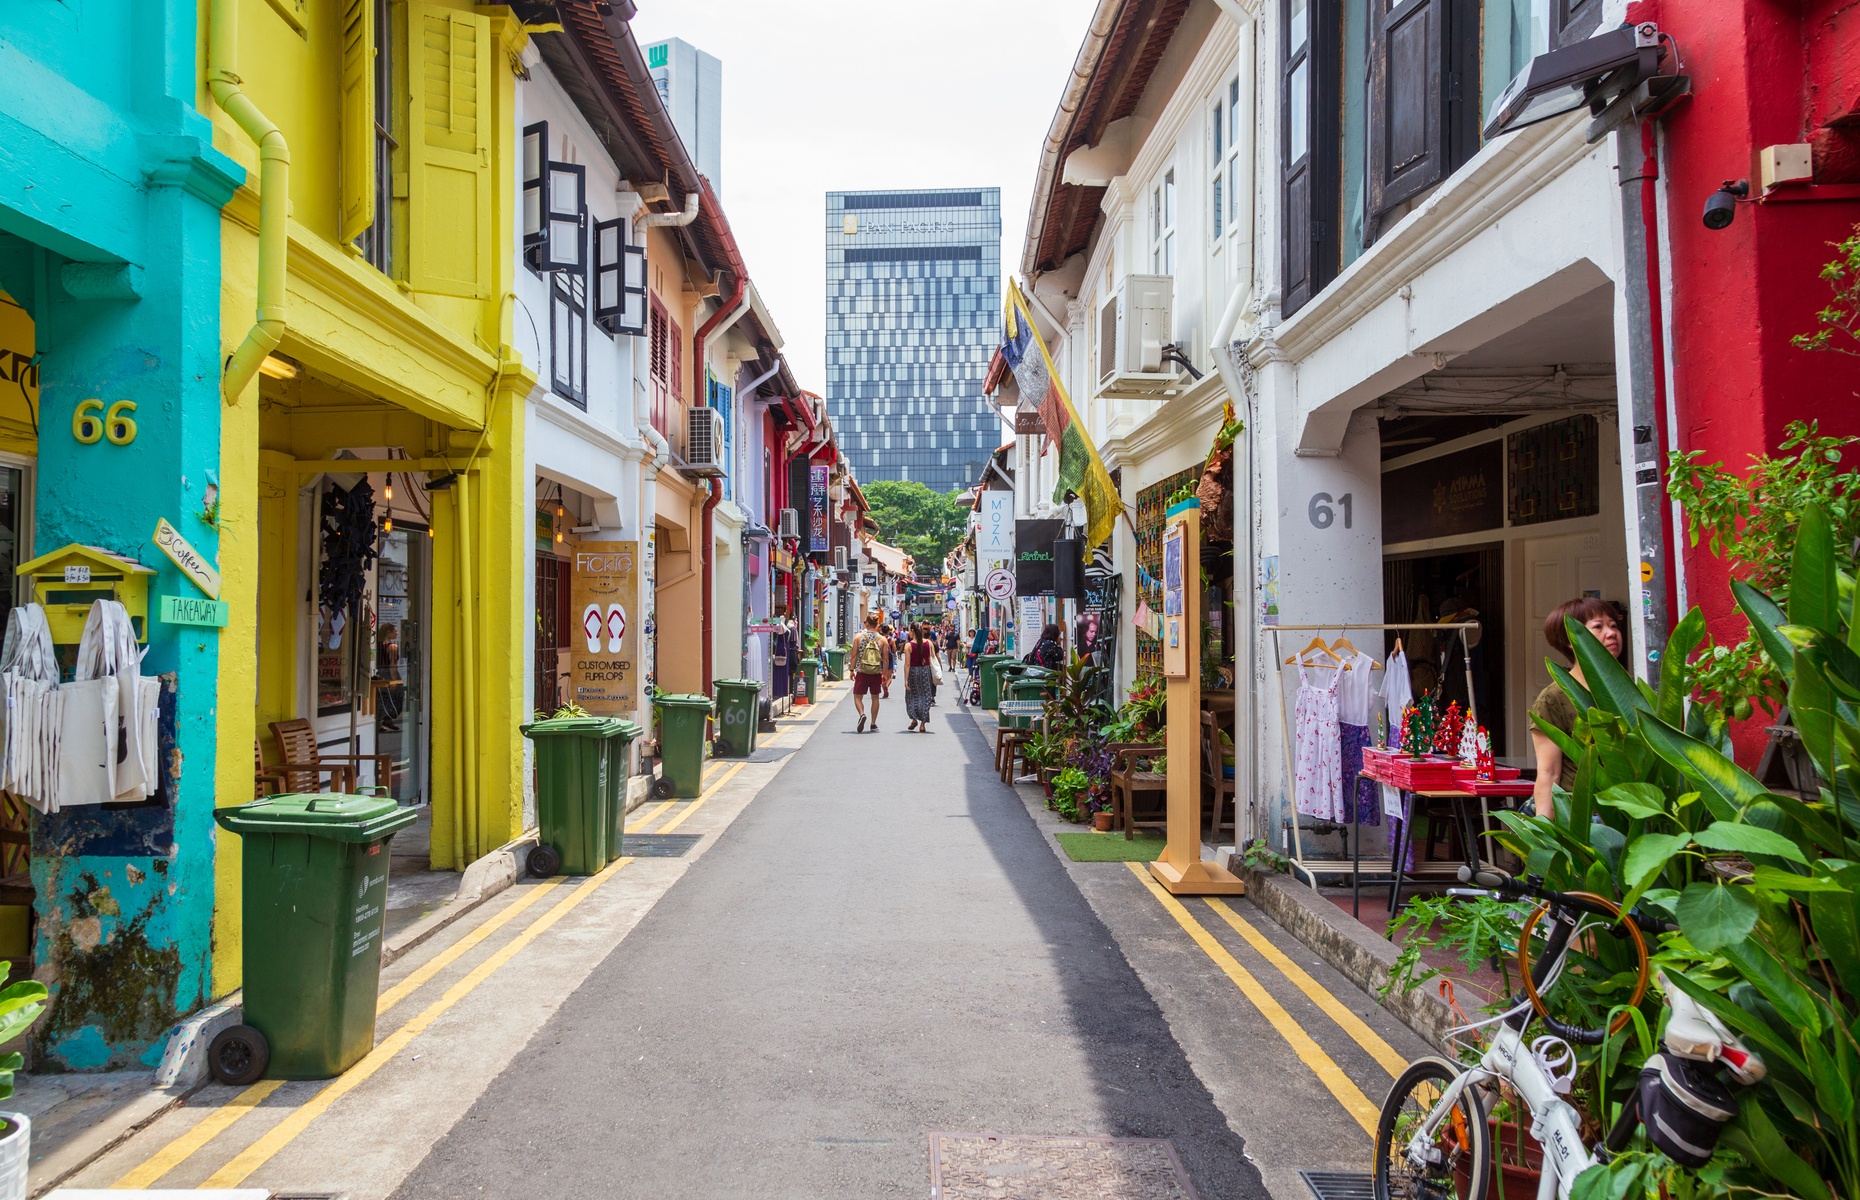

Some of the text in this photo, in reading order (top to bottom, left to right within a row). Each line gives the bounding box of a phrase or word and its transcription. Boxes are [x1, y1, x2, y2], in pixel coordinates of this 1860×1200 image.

[866, 220, 955, 235] PAN PACIFIC
[72, 398, 138, 446] 66
[1308, 491, 1353, 530] 61
[172, 538, 211, 582] Coffee
[172, 598, 217, 624] TAKEAWAY
[577, 660, 631, 670] CUSTOMISED
[585, 671, 624, 681] FLIPFLOPS
[725, 706, 747, 725] 60
[1553, 1129, 1571, 1159] HA-01
